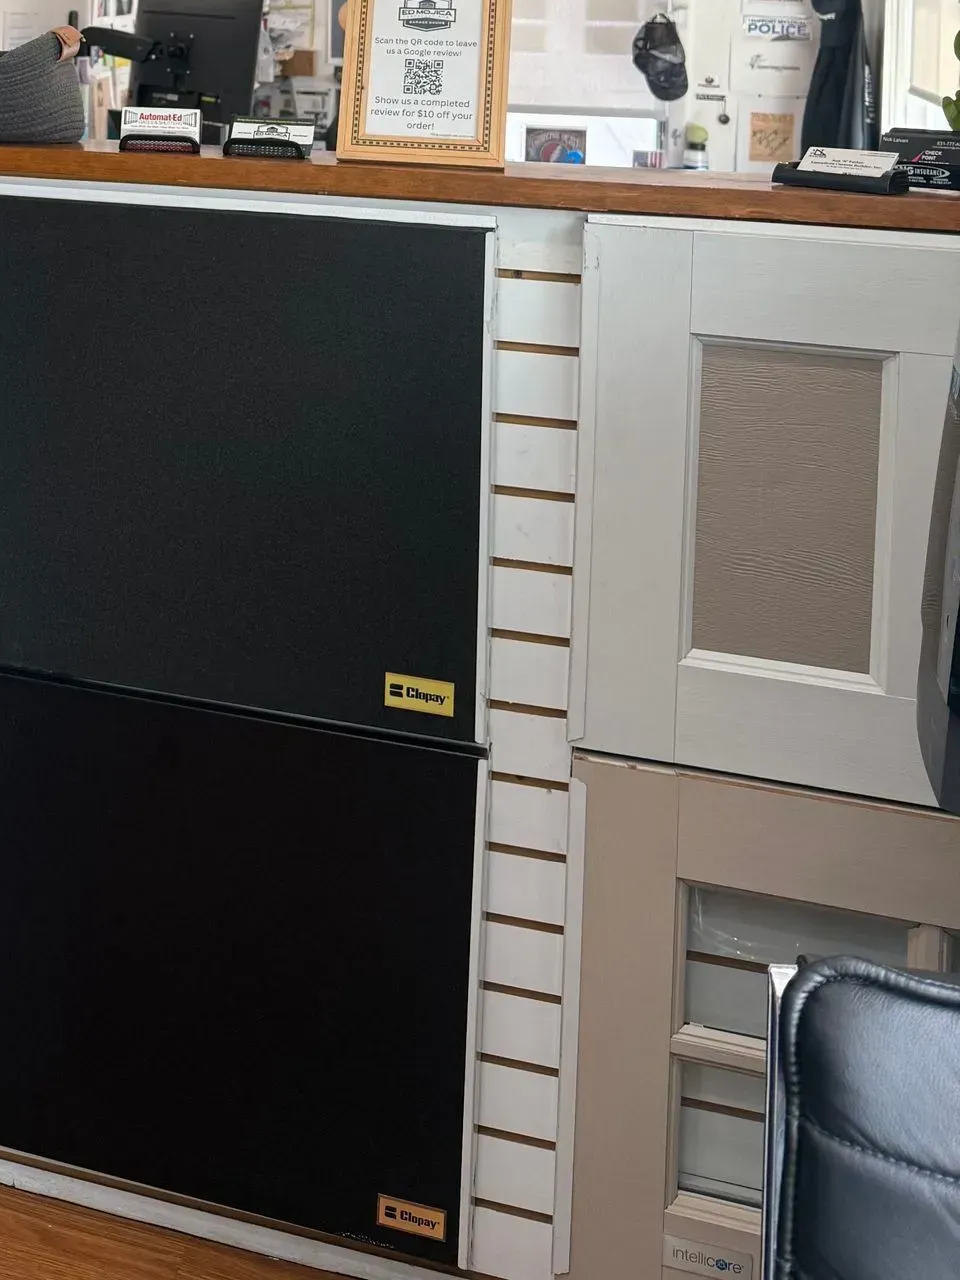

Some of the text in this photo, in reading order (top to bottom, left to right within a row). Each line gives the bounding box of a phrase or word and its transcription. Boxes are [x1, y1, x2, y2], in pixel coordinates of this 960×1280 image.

[416, 9, 452, 17] MOJICA
[748, 22, 807, 36] POLICE
[396, 37, 408, 45] the
[410, 38, 422, 46] QR
[424, 38, 443, 46] code
[403, 48, 431, 57] Google
[433, 49, 462, 57] review!
[375, 96, 399, 105] Show
[421, 99, 470, 108] completed
[370, 108, 473, 121] review for $10 off your
[406, 122, 434, 130] order!
[406, 686, 446, 706] Clopay
[400, 1209, 437, 1230] Clopay
[672, 1247, 743, 1274] intellicore
